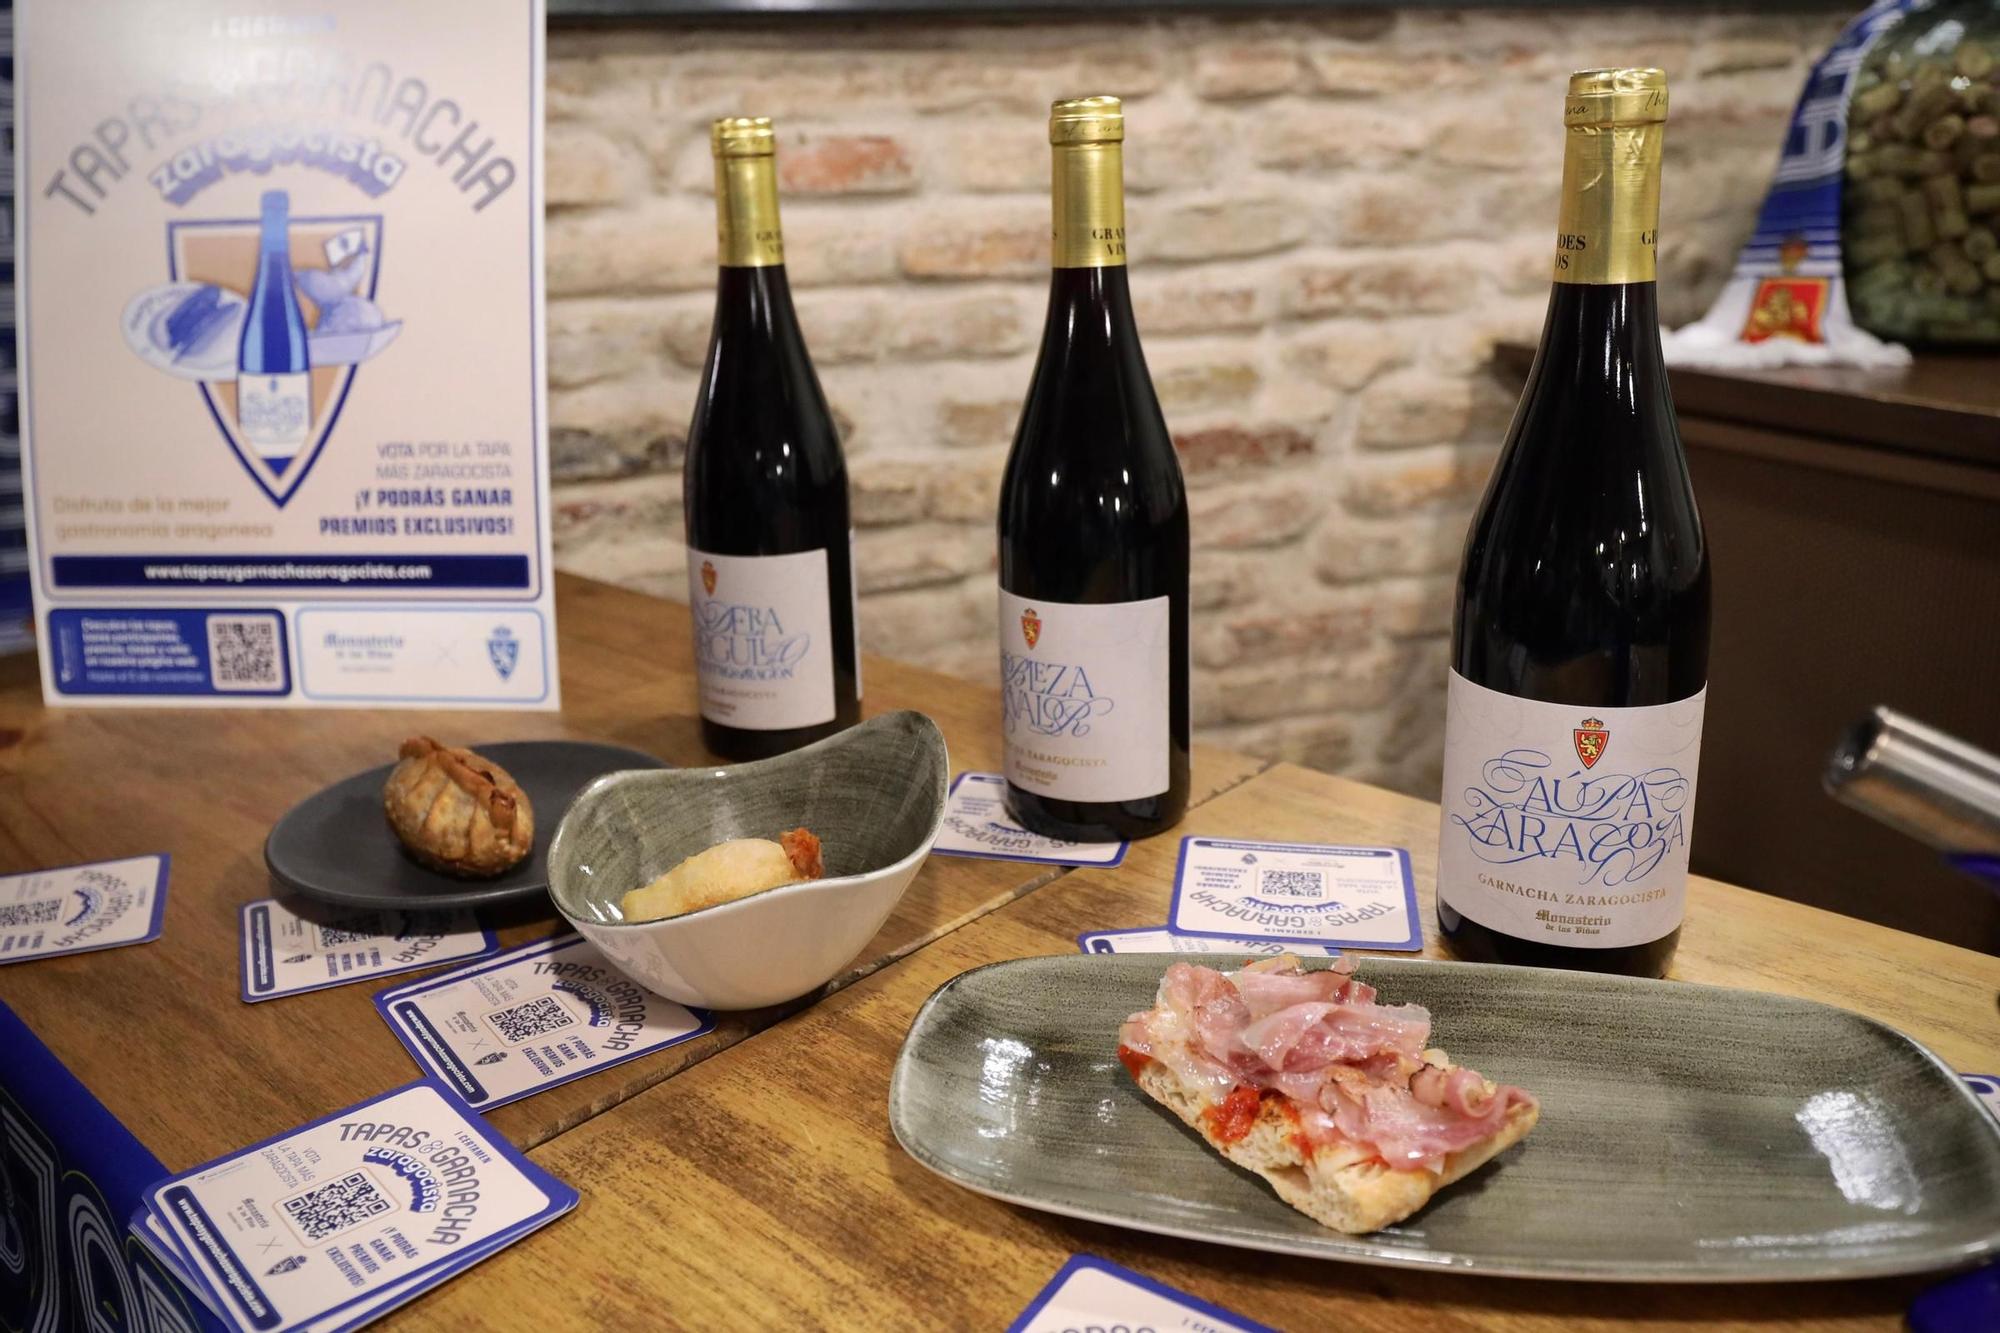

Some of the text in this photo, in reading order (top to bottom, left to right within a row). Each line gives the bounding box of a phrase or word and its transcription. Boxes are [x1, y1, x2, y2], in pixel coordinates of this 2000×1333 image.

[148, 126, 407, 205] zaragocista
[377, 443, 414, 457] VOTA
[377, 486, 445, 506] PODRÁS
[452, 489, 512, 506] GANAR
[319, 517, 514, 535] PREMIOS EXCLUSIVOS!
[1452, 793, 1684, 880] ZARAGOZA
[1478, 873, 1667, 906] GARNACHA ZARAGOCISTA
[1189, 890, 1306, 928] GARNACHA
[1325, 902, 1397, 927] TAPAS
[1535, 909, 1612, 927] Monasterio
[534, 961, 606, 981] TAPAS
[602, 980, 646, 1051] GARNACHA
[555, 979, 613, 1027] zaragocista
[541, 1045, 566, 1068] PREMIOS
[557, 1043, 579, 1061] GANAR
[459, 1134, 492, 1164] CERTAMEN
[340, 1122, 480, 1246] TAPAS & GARNACHA
[365, 1146, 442, 1213] zaragocista
[349, 1243, 380, 1275] PREMIOS
[369, 1238, 396, 1263] GANAR
[389, 1231, 419, 1259] PODRÁS
[325, 1246, 366, 1288] EXCLUSIVOS!
